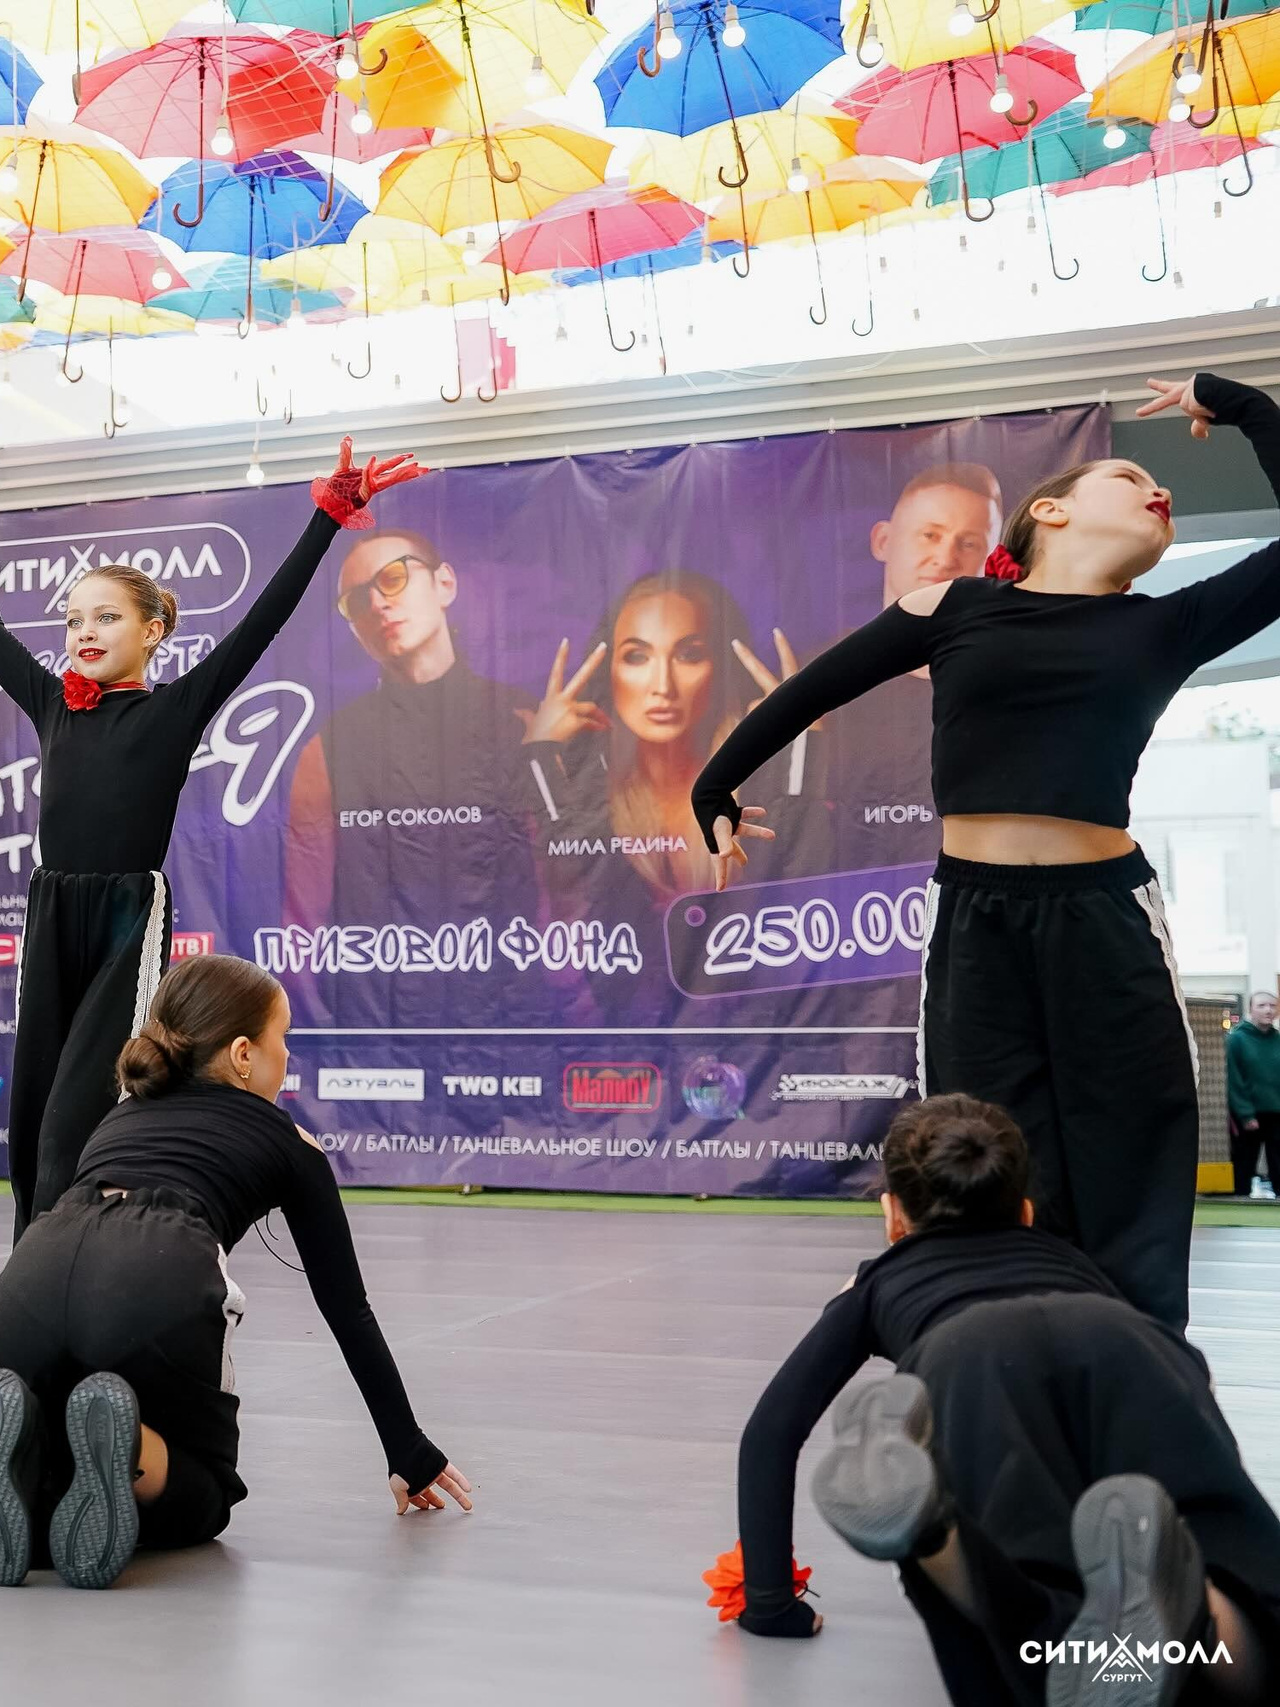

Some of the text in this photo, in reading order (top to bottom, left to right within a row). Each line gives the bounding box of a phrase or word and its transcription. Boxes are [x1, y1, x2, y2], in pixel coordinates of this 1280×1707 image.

[339, 805, 482, 828] ЕГОР СОКОЛОВ
[864, 804, 934, 824] ИГОРЬ
[548, 836, 688, 856] МИЛА РЕДИНА
[253, 916, 643, 975] ПРИЗОВОЙ ФОНД
[442, 1076, 542, 1097] TWO KEI
[315, 1132, 350, 1152] ОУ
[365, 1134, 434, 1154] БАТТЛЫ
[451, 1135, 602, 1157] ТАНЦЕВАЛЬНОЕ
[606, 1138, 657, 1157] ШОУ
[676, 1139, 751, 1160] БАТТЛЫ
